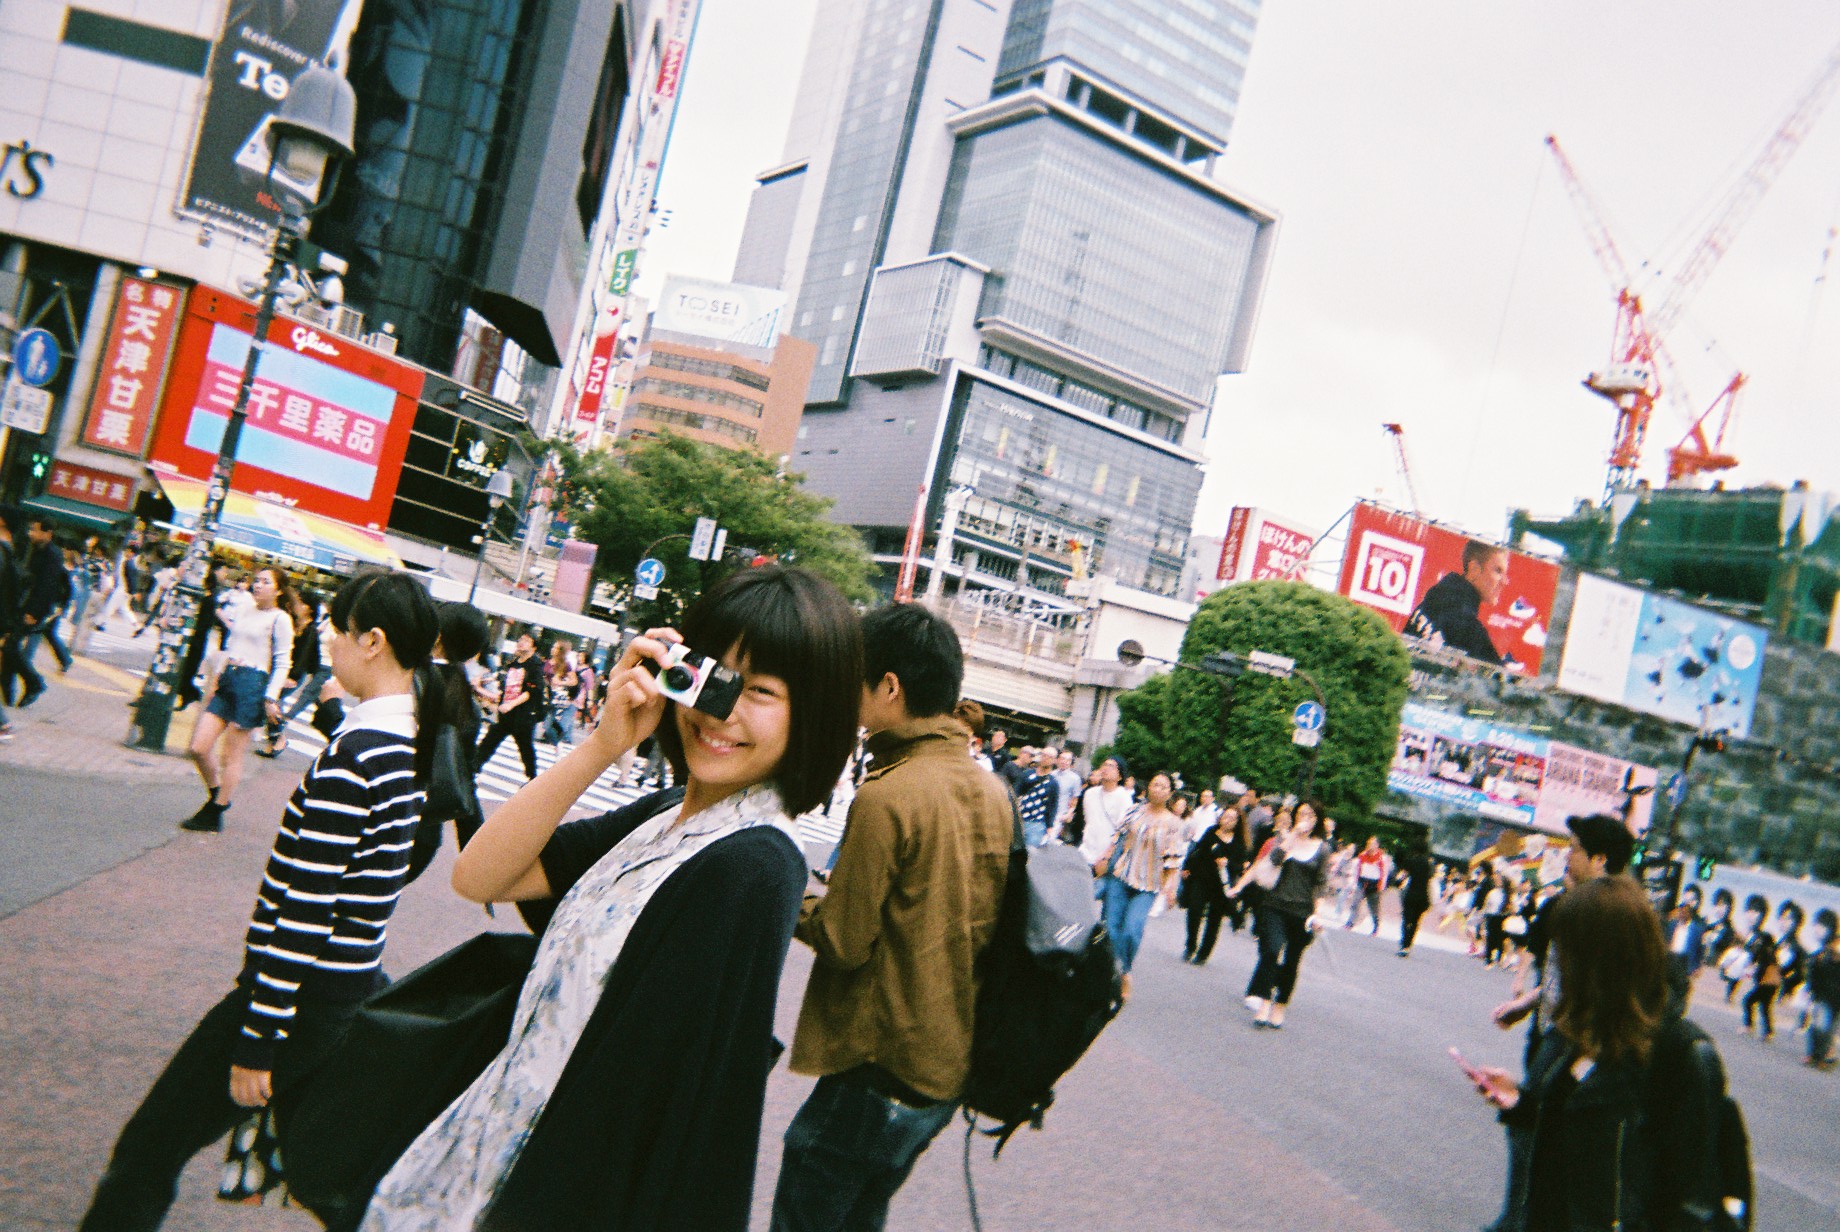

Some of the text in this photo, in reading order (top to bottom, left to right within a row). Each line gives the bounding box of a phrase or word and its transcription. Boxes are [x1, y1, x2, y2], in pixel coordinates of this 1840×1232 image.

[235, 51, 290, 100] Te
[95, 304, 162, 446] 天津甘栗
[291, 327, 341, 357] Glico
[208, 369, 376, 455] 三千里薬品
